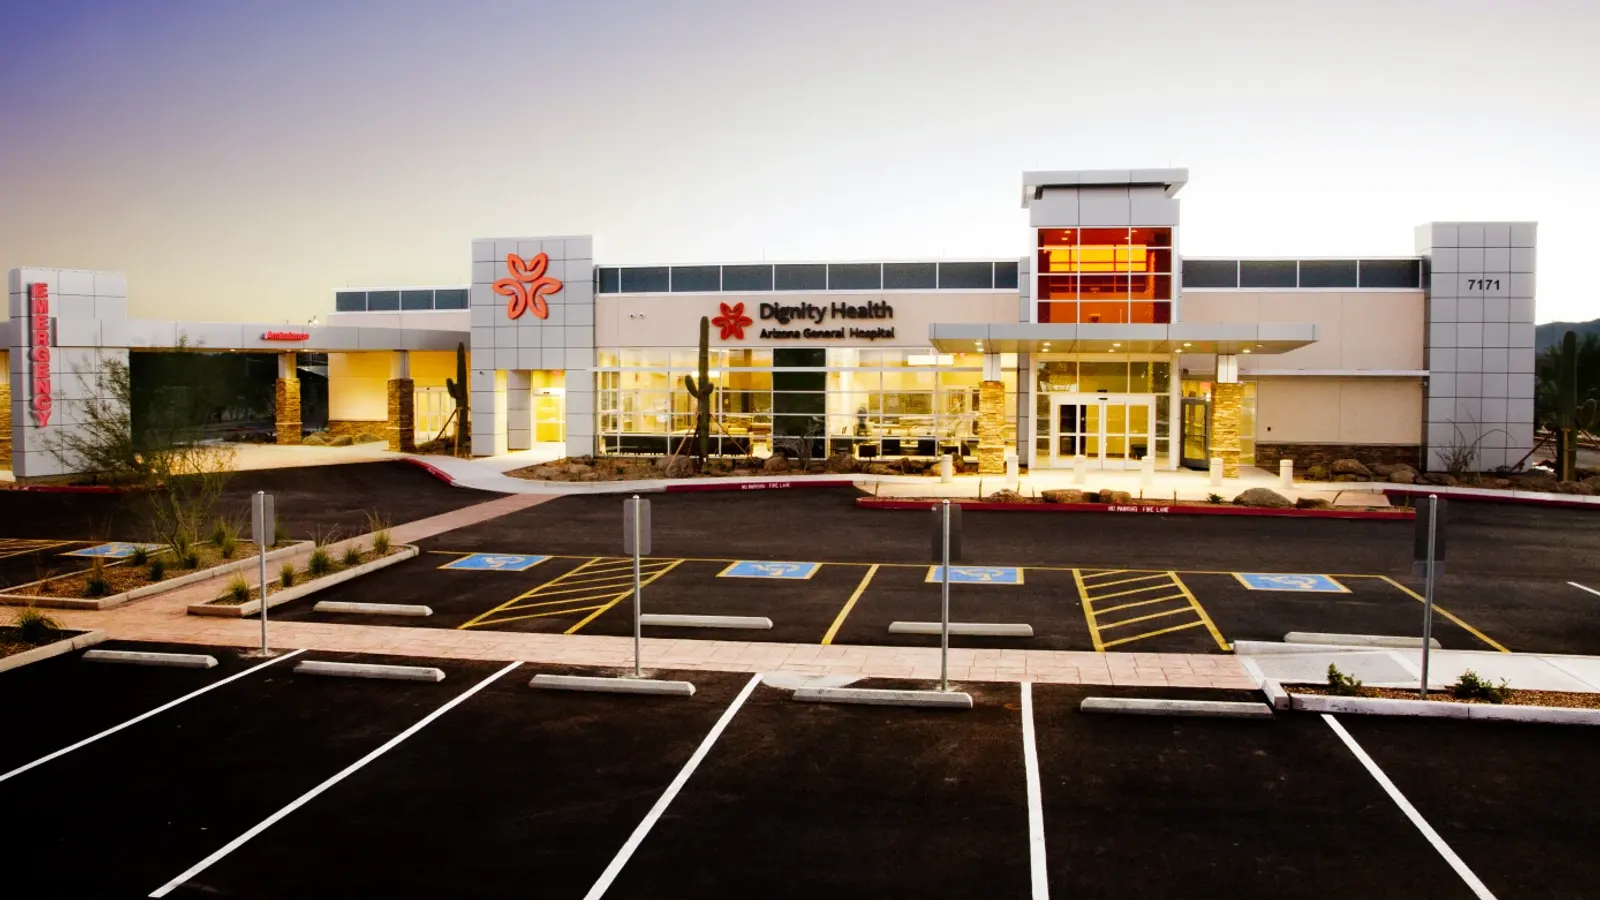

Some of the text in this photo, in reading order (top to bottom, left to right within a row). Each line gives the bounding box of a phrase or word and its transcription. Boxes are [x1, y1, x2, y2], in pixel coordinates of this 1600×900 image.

[1468, 279, 1499, 290] 7171
[760, 300, 893, 324] Dignity Health
[264, 330, 309, 341] Ambulance
[760, 327, 895, 341] Arizona General Hospital
[31, 282, 52, 428] EMERGENCY
